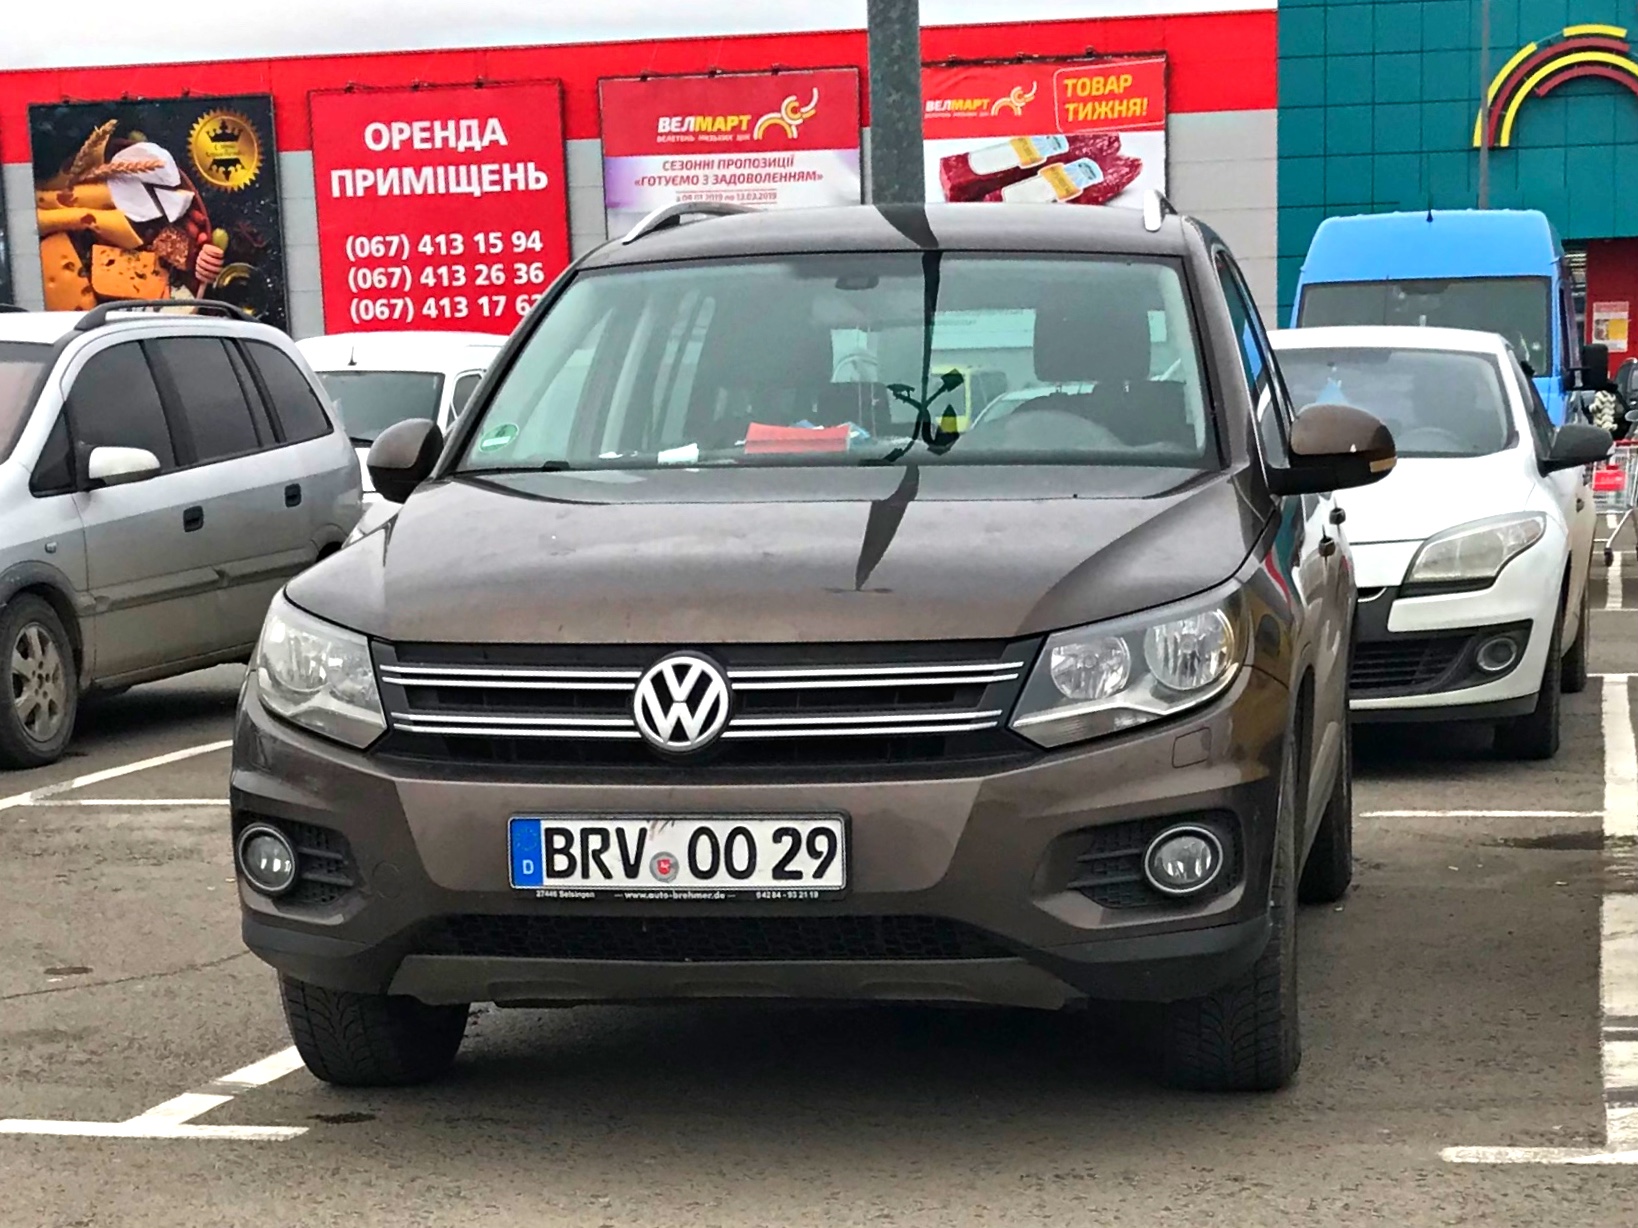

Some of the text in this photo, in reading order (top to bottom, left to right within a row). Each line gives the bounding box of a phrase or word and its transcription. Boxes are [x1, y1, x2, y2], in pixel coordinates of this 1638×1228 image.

[1063, 73, 1132, 98] ТОВАР
[926, 98, 990, 112] ВЕЛМАРТ
[1065, 98, 1149, 122] ТИЖНЯ!
[363, 117, 508, 151] ОРЕНДА
[657, 115, 751, 133] ВЕЛМАРТ
[662, 154, 795, 172] СЕЗОННІ ПРОПОЗИЦІЇ
[330, 162, 549, 198] ПРИМІЩЕНЬ
[634, 170, 824, 187] «ГОТУЄМО З ЗАДОВОЛЕННЯМ»
[345, 230, 543, 262] (067) 413 15 94
[348, 262, 545, 294] (067) 413 26 36
[350, 297, 415, 324] (067)
[422, 297, 469, 319] 413
[477, 295, 507, 317] 17
[634, 656, 729, 752] VW
[544, 826, 648, 880] BRV
[771, 826, 838, 880] 29
[522, 859, 535, 875] D
[624, 889, 726, 899] www.auto-brehmer.de
